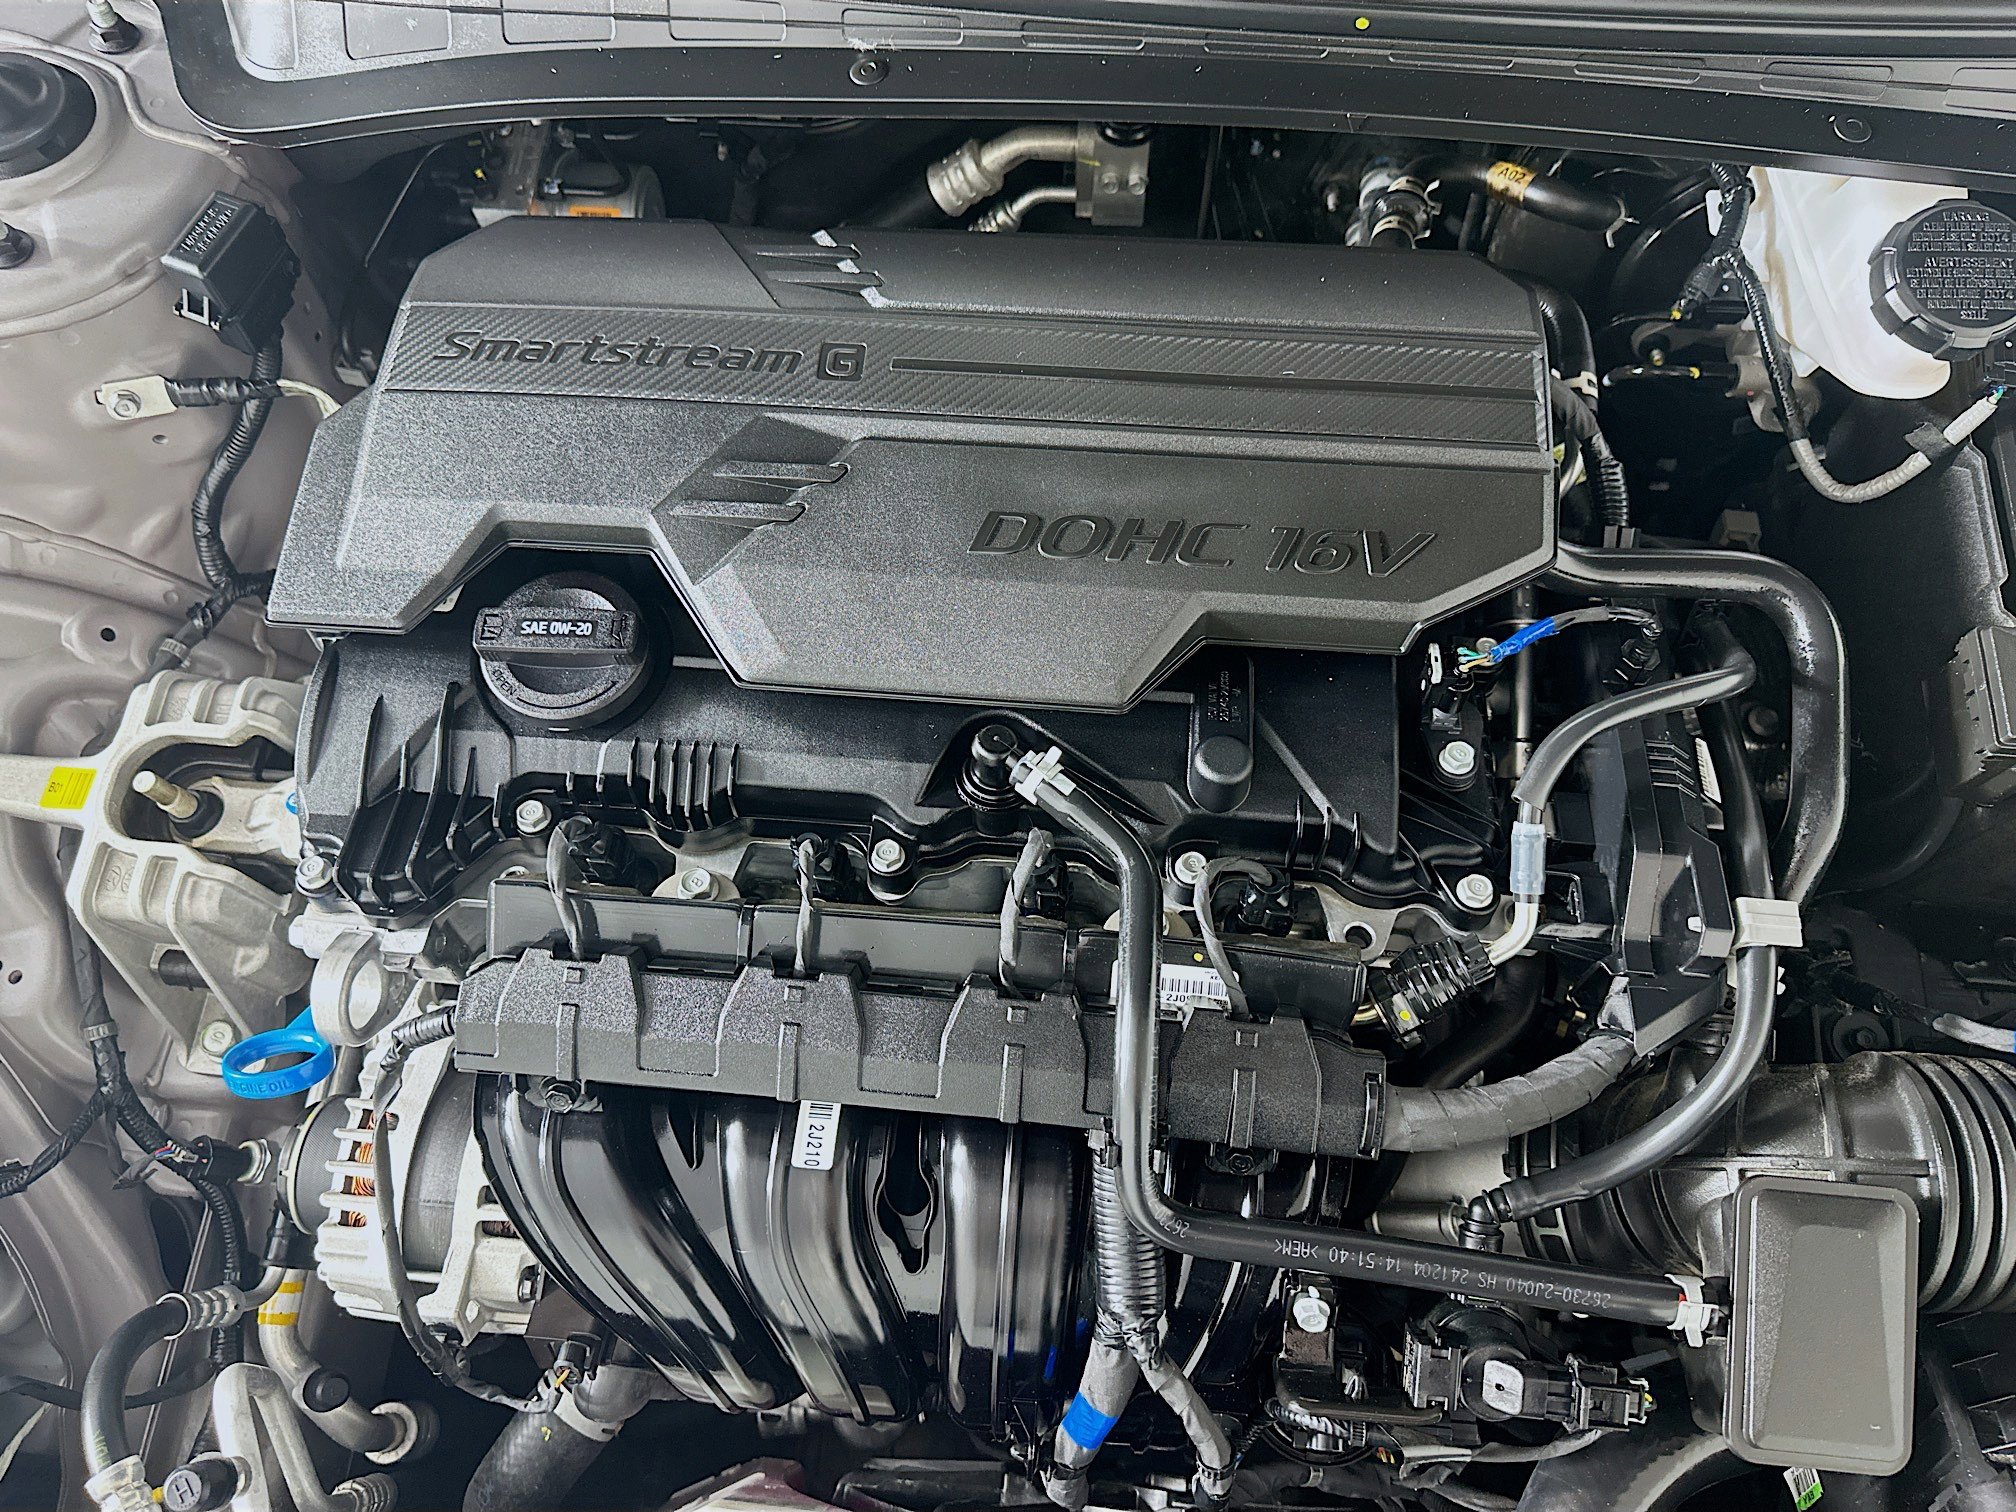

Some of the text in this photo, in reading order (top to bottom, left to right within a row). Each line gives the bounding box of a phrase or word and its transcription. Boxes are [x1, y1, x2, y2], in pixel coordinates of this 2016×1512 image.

[1497, 167, 1526, 185] A02
[432, 330, 862, 379] Smartstream G
[966, 510, 1437, 578] DOHC 16V
[520, 621, 593, 636] SAE 0W-20
[491, 667, 518, 697] OPEN
[47, 780, 64, 794] B01
[804, 1124, 825, 1167] 2J210
[1328, 1246, 1401, 1273] 14:51:40
[1412, 1260, 1468, 1286] 241204
[1477, 1271, 1498, 1290] HS
[1505, 1276, 1612, 1310] 26730-2J040
